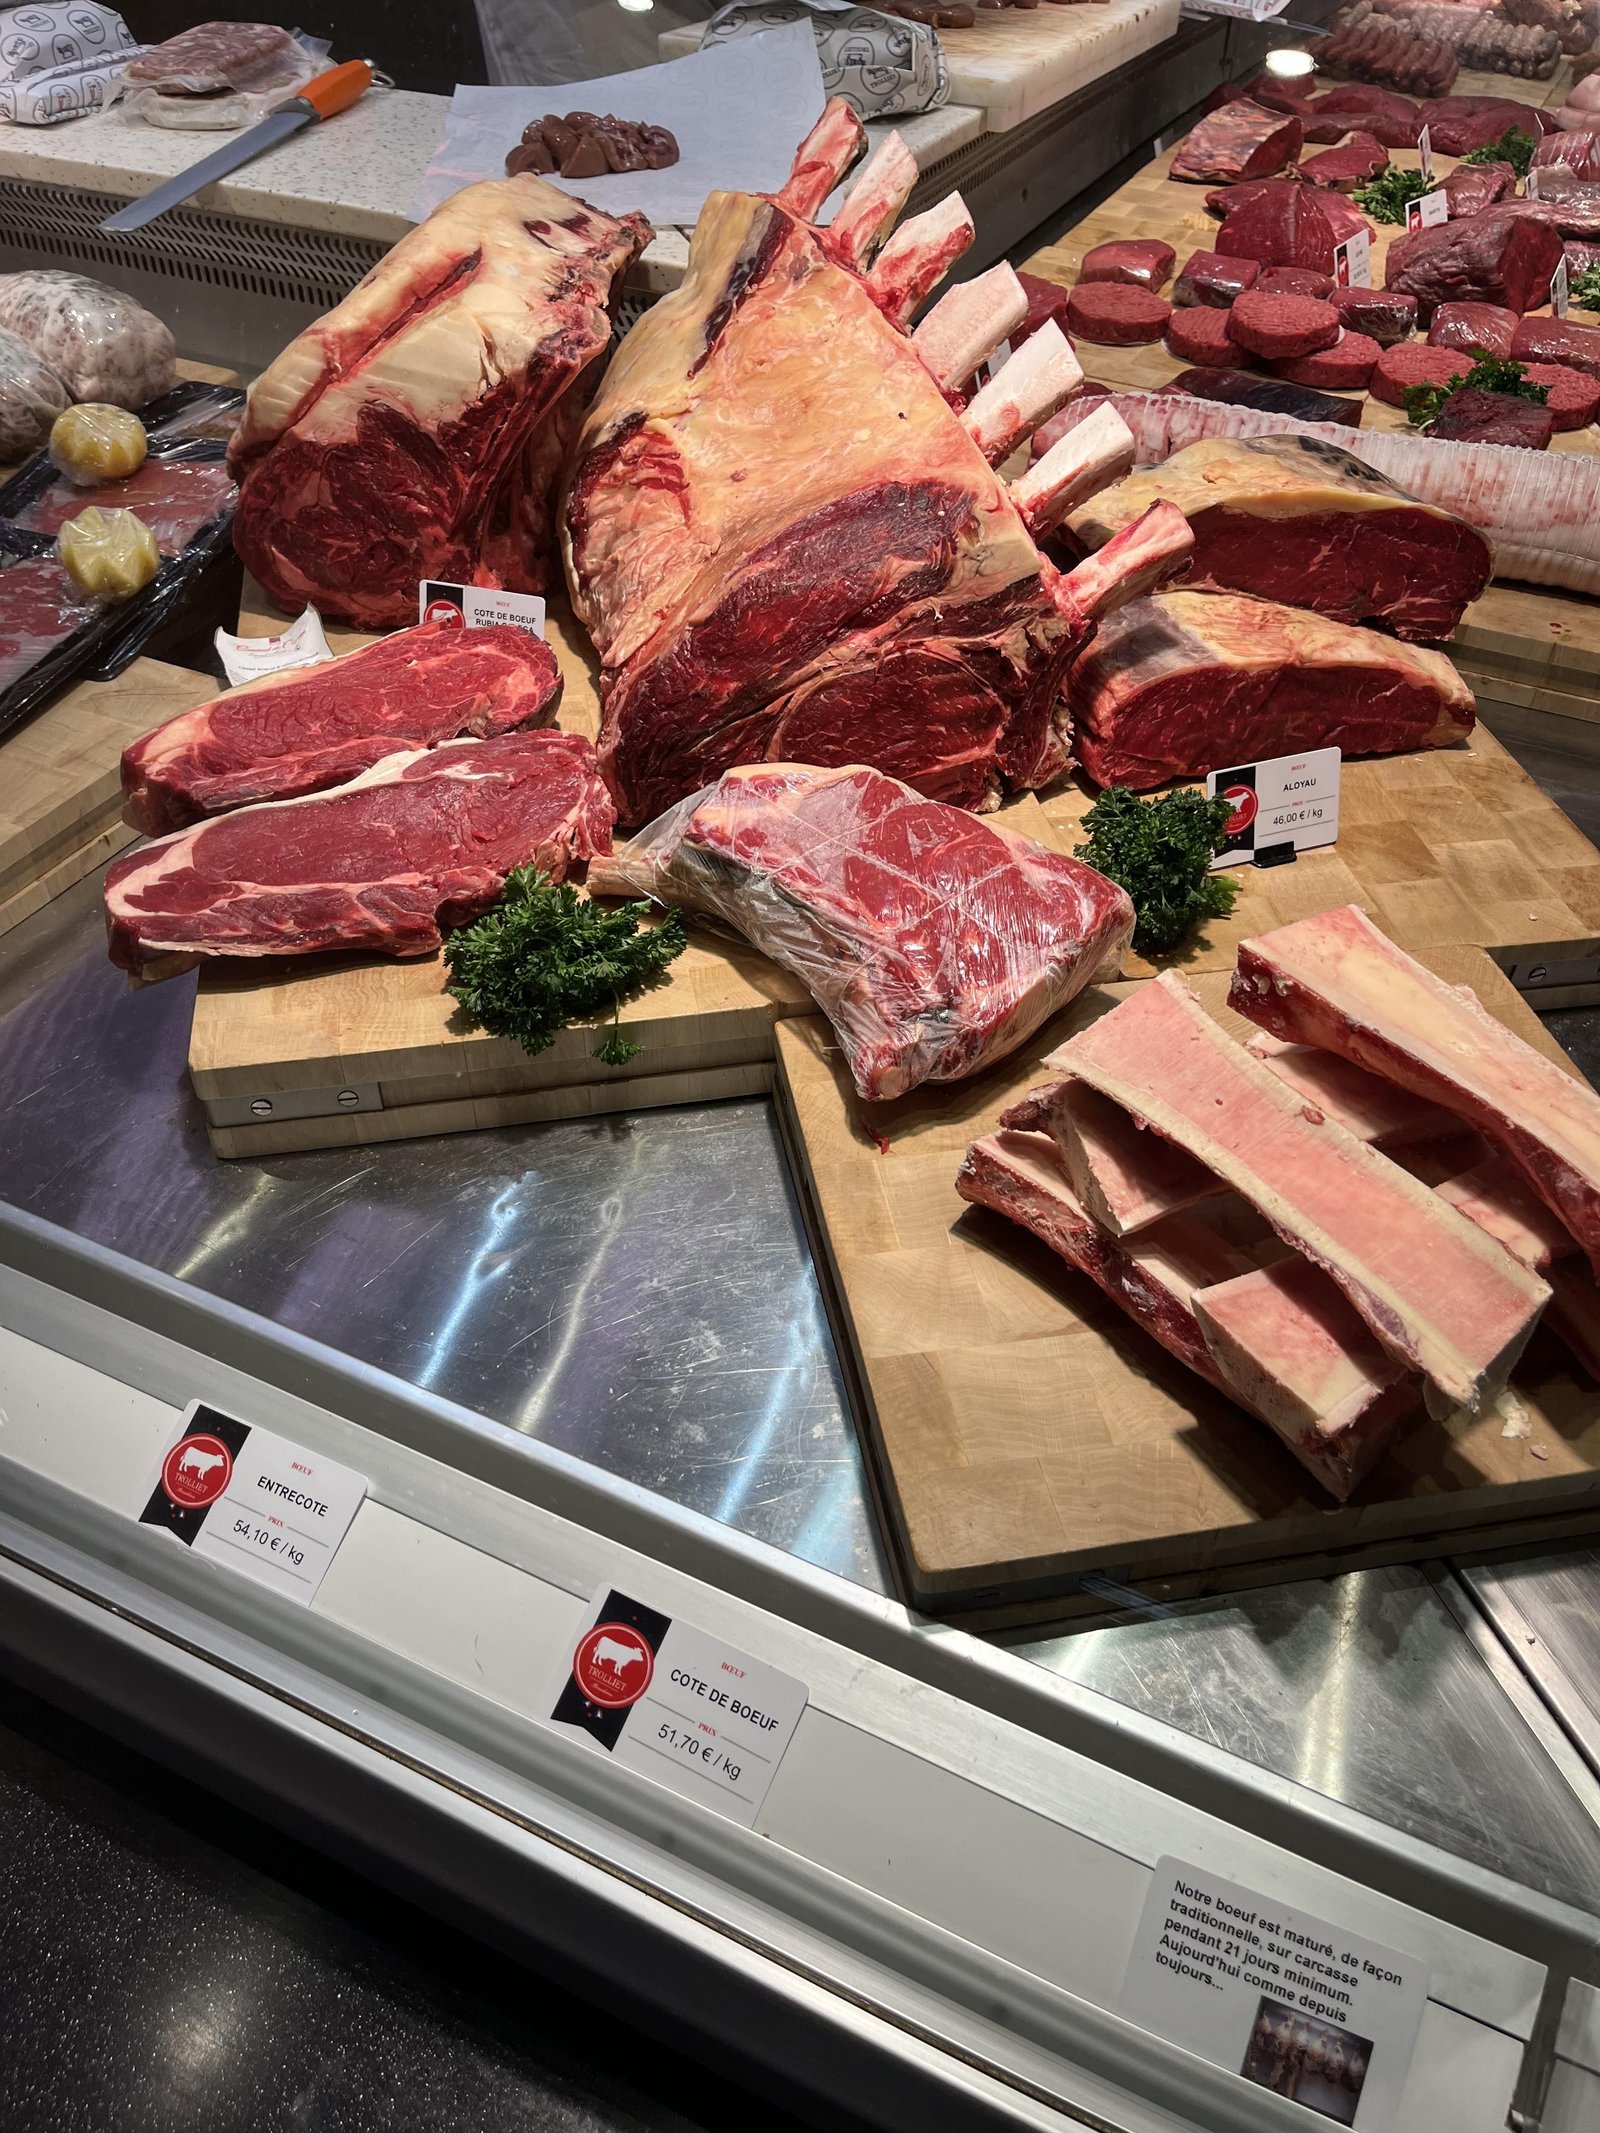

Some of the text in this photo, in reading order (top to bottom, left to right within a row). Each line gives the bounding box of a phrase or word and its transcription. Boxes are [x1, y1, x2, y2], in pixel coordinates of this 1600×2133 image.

[474, 608, 536, 624] COTE DE BOEUF
[1283, 778, 1317, 792] ALOYAU
[1312, 808, 1323, 818] kg
[175, 1472, 208, 1493] TROLLIET
[257, 1475, 328, 1518] ENTRECOTE
[233, 1518, 269, 1546] 54,10
[270, 1537, 282, 1551] €
[288, 1545, 304, 1565] kg
[268, 1515, 284, 1528] PRIX
[588, 1665, 627, 1691] TROLLIET
[670, 1668, 779, 1732] COTE DE BOEUF
[698, 1721, 718, 1737] PRIX
[657, 1723, 699, 1755] 51,70
[701, 1747, 714, 1762] €
[722, 1756, 742, 1781] kg
[1170, 1898, 1359, 1987] traditionnelle, sur carcasse
[1174, 1880, 1403, 1986] Notre boeuf est maturé, de façon
[1155, 1950, 1224, 1992] toujours...
[1159, 1933, 1347, 2023] Aujourd'hui comme depuis
[1164, 1916, 1353, 2006] pendant 21 jours minimum.
